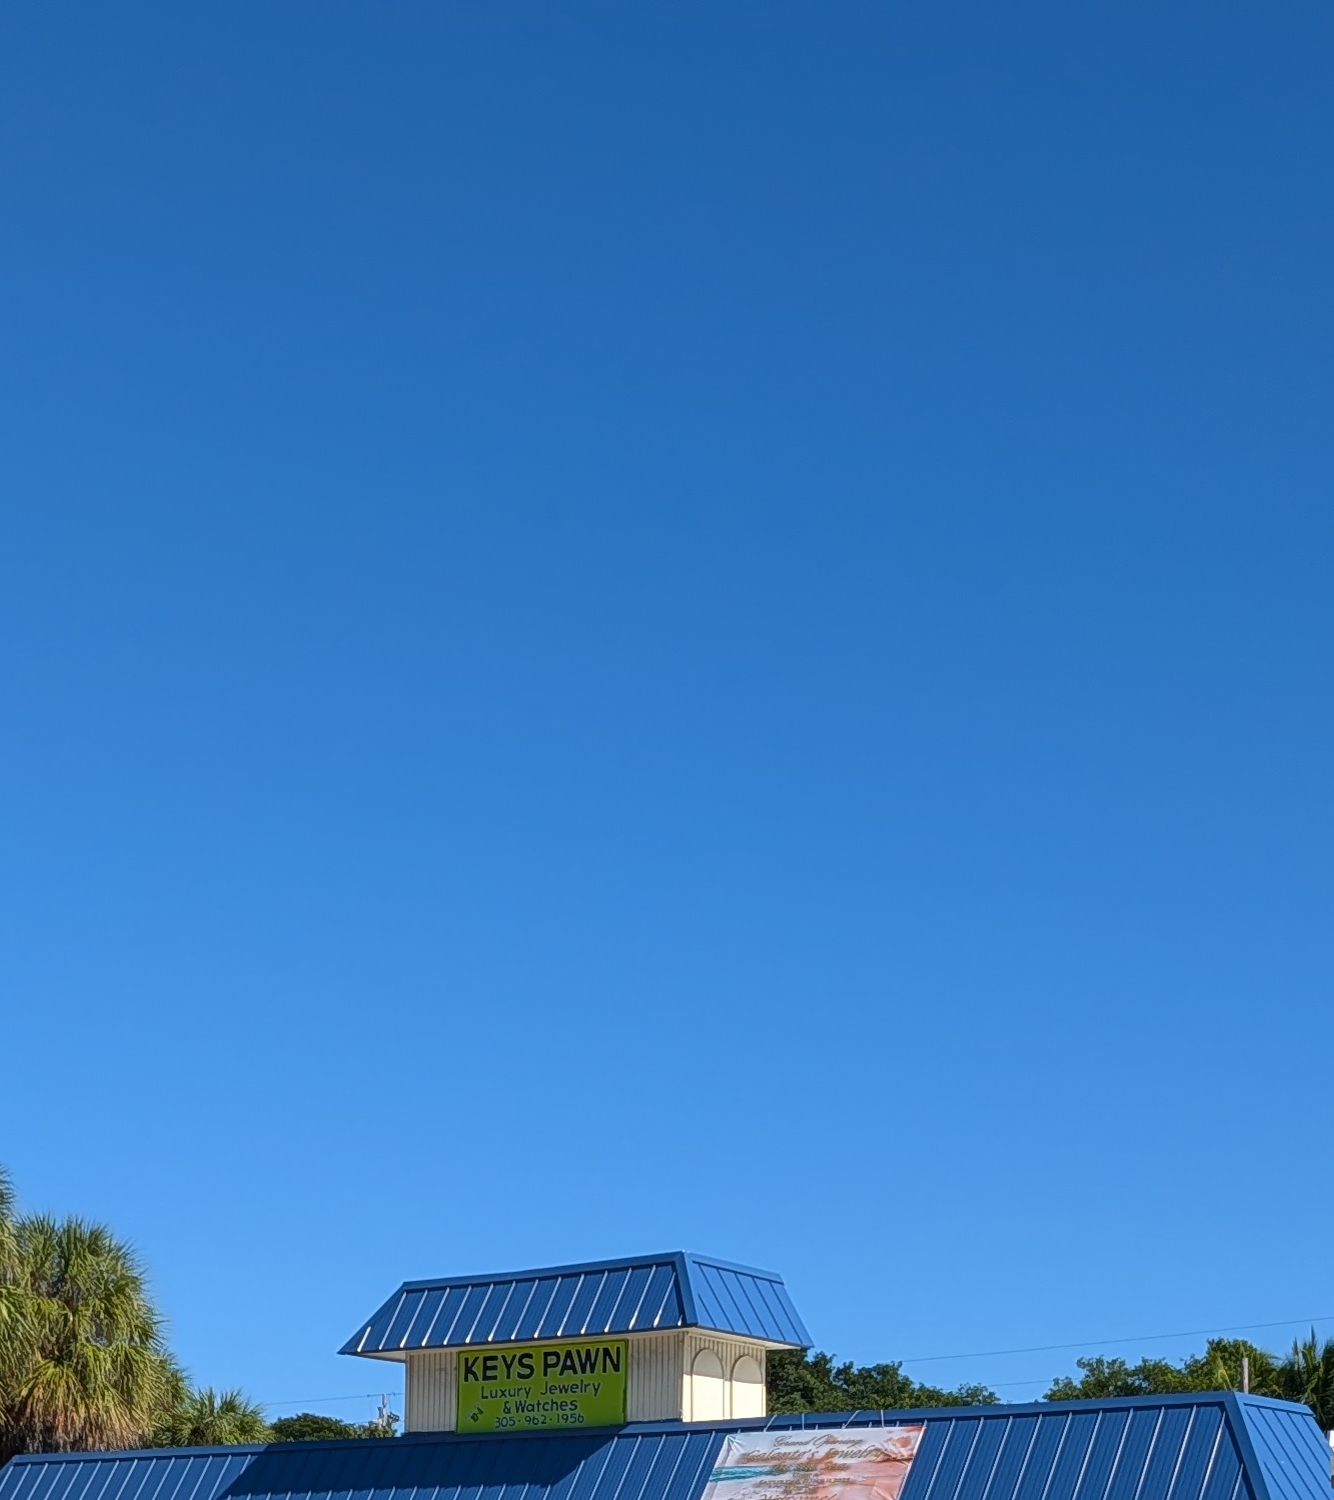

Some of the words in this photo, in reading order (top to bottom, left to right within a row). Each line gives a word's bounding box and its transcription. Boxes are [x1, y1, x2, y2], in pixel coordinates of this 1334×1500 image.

[464, 1352, 535, 1382] KEYS
[543, 1346, 621, 1377] PAWN
[481, 1386, 532, 1399] Luxury
[540, 1380, 601, 1397] Jewelry
[503, 1401, 511, 1414] &
[515, 1399, 578, 1413] Watches
[495, 1413, 585, 1428] 305-962-1956
[774, 1436, 811, 1446] Grand
[813, 1434, 863, 1448] Opening
